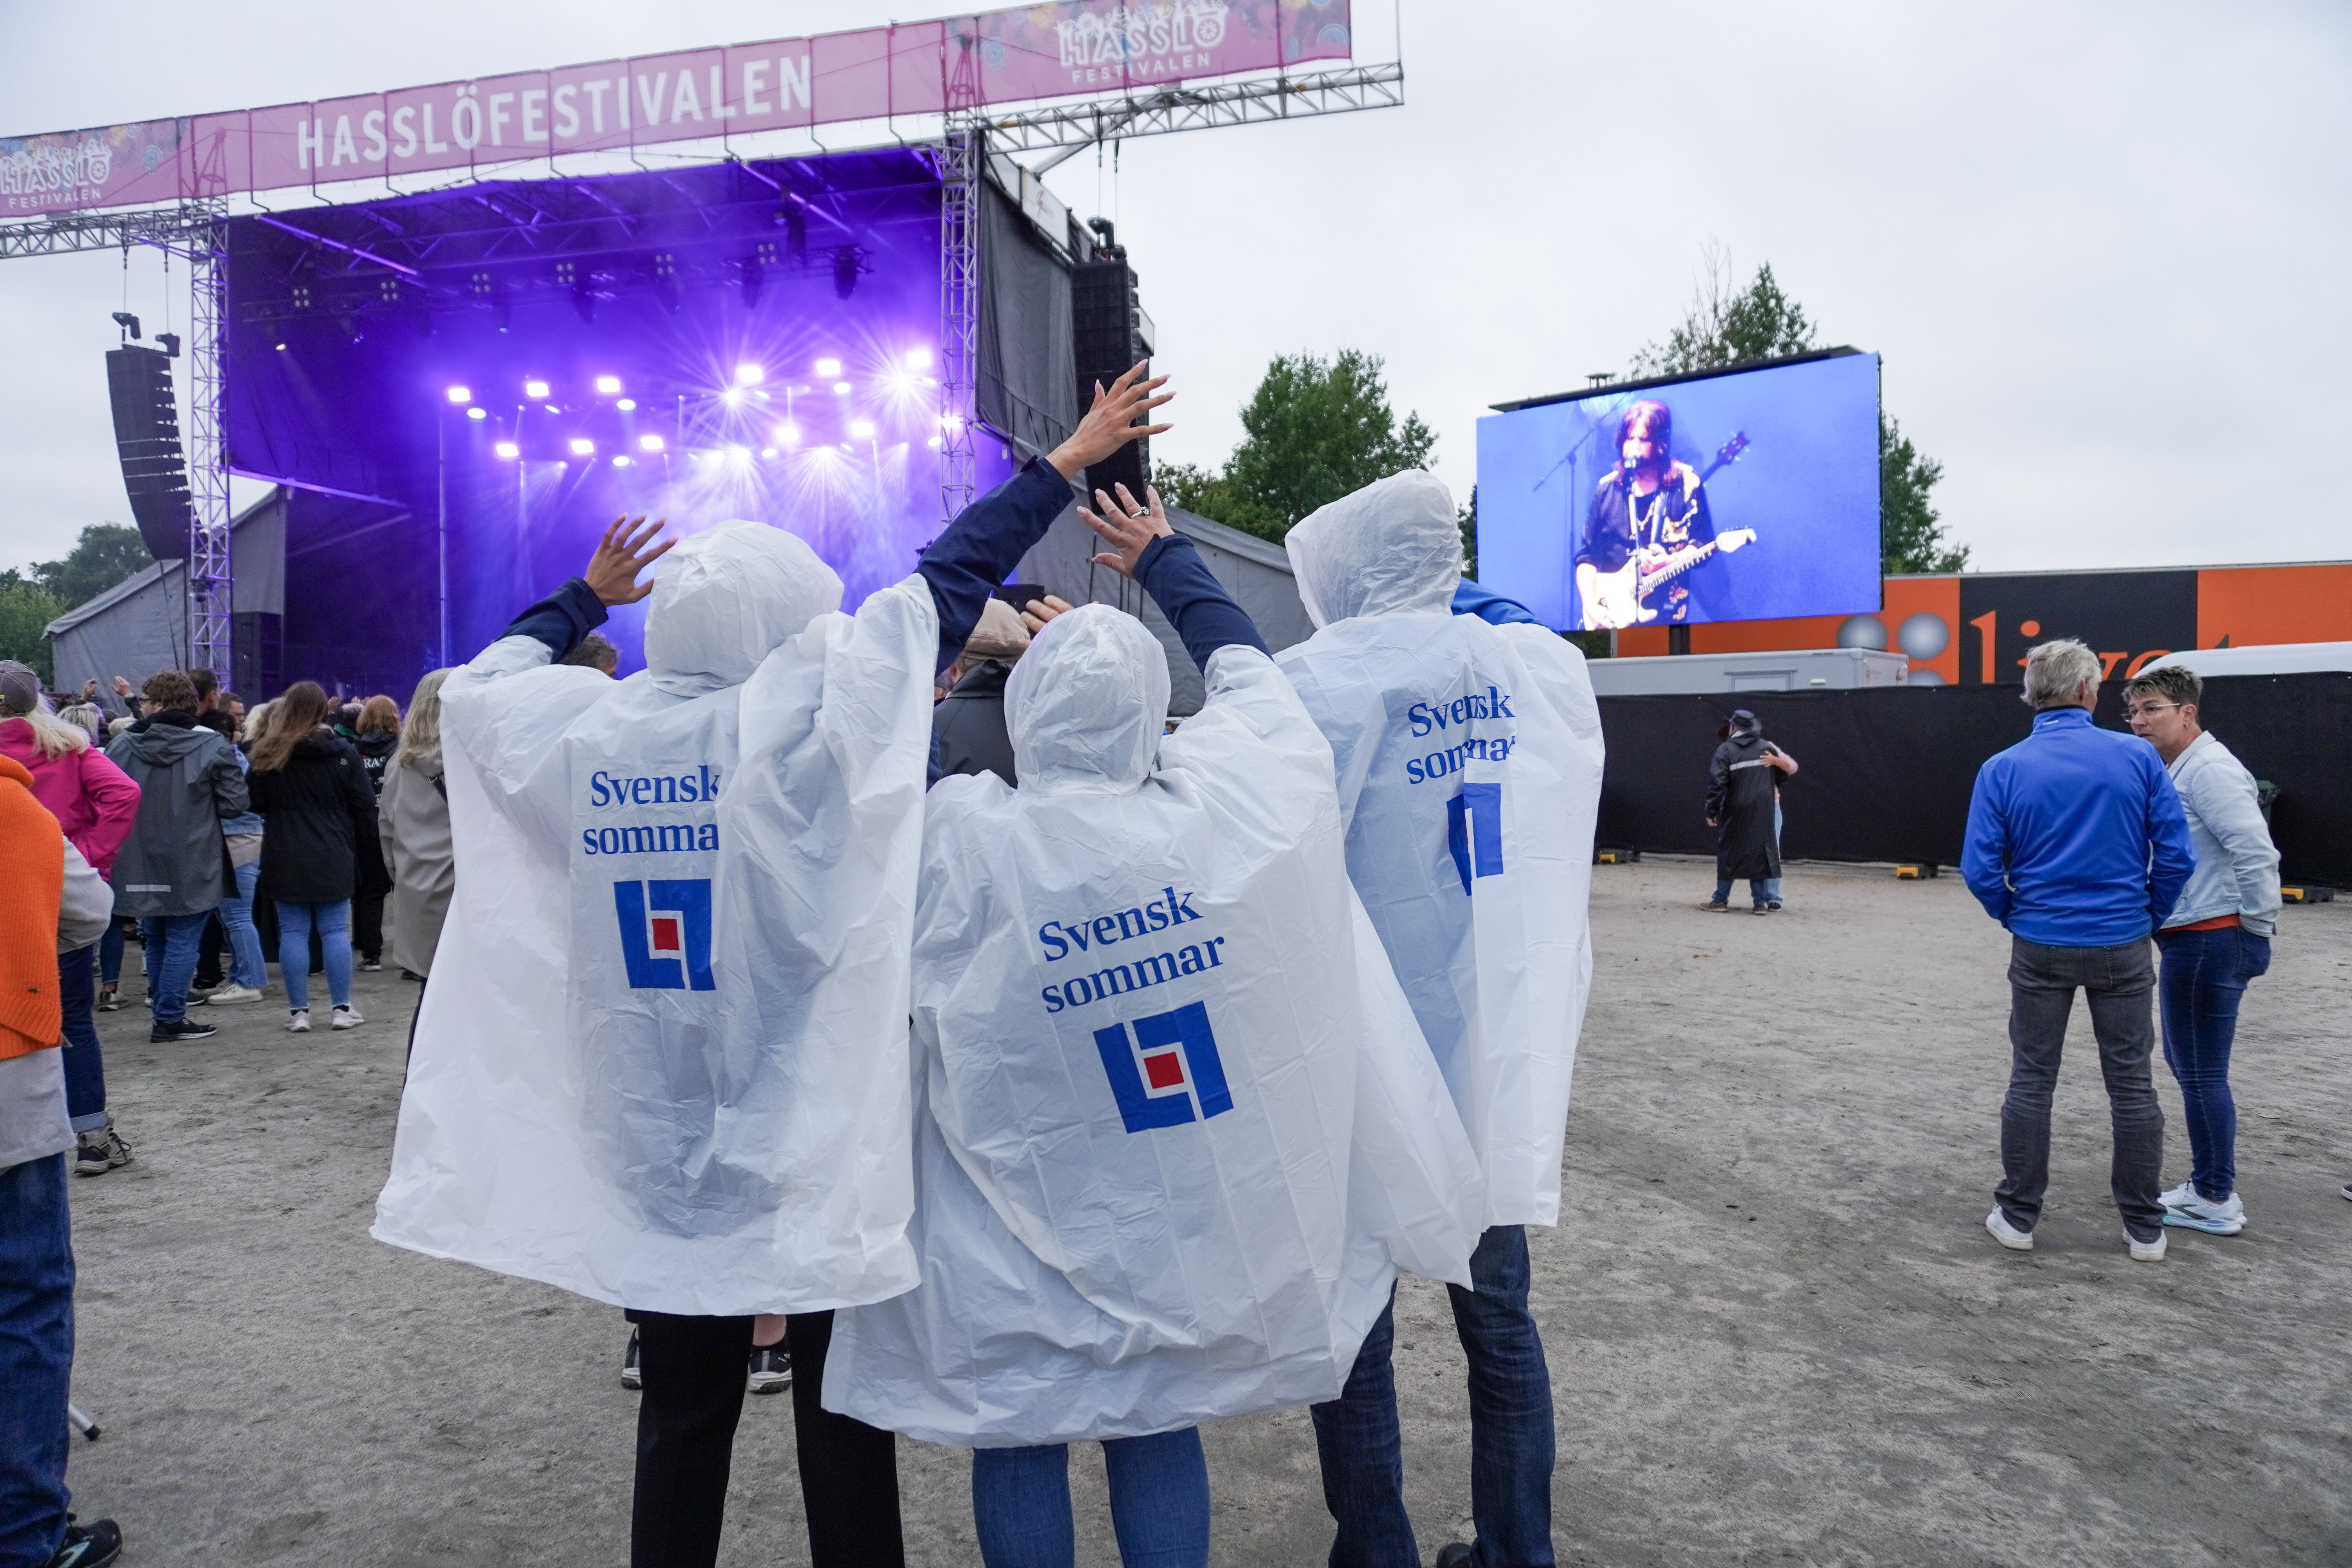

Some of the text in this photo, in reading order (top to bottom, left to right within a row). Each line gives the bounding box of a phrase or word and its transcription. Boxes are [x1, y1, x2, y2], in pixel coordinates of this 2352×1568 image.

[1071, 53, 1210, 83] FESTIVALEN
[298, 55, 812, 170] HASSLÖFESTIVALEN
[9, 189, 101, 208] FESTIVALEN
[1408, 686, 1515, 737] Svensk
[591, 765, 720, 807] Svensk
[583, 823, 719, 855] somma
[1039, 886, 1203, 962] Svensk
[1042, 936, 1225, 1013] sommar
